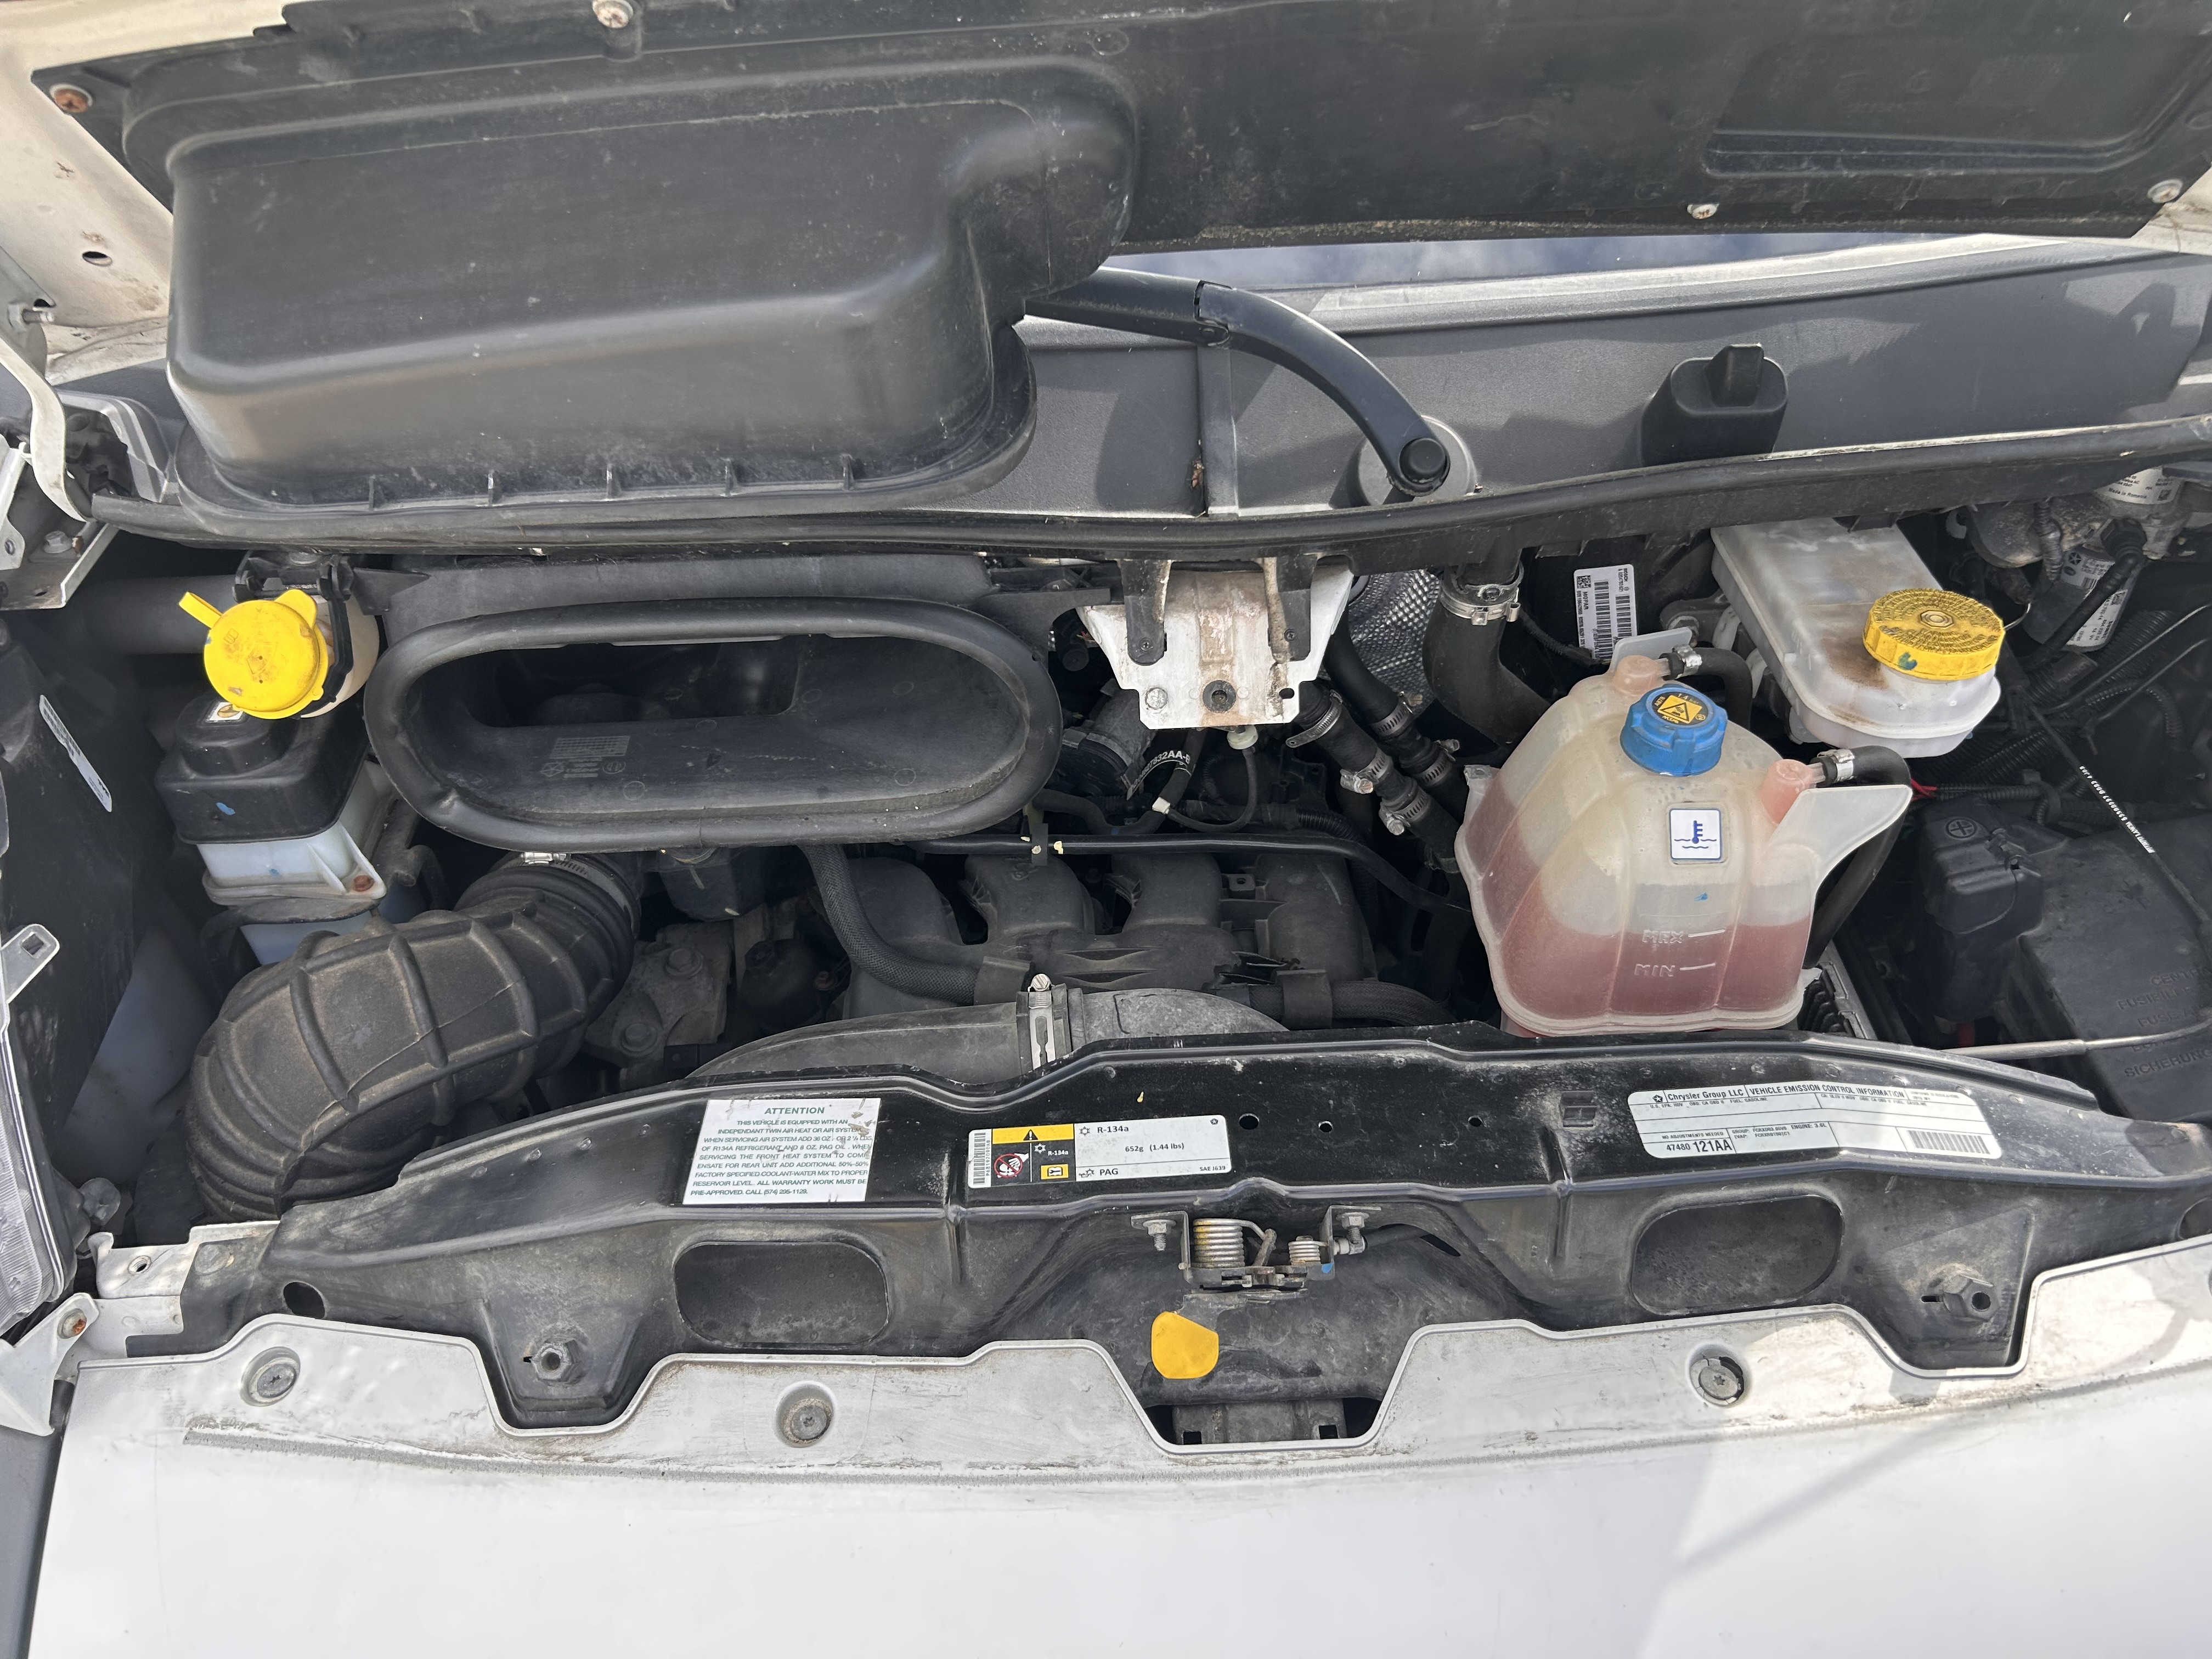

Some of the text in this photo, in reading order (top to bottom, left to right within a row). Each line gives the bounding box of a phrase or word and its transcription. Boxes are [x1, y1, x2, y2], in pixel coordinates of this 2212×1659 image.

[1642, 929, 1684, 944] MAX
[1634, 963, 1675, 977] MIN
[1667, 1091, 1700, 1102] Chrysler
[1702, 1090, 1726, 1101] Group
[1749, 1086, 1782, 1095] VEHICLE
[1784, 1084, 1821, 1093] EMISSION
[1821, 1084, 1855, 1094] CONTROL
[1856, 1087, 1905, 1098] INFORMATION
[1097, 1125, 1129, 1133] R-134a
[1149, 1144, 1169, 1152] (1.44
[1667, 1139, 1733, 1153] 47480 121AA
